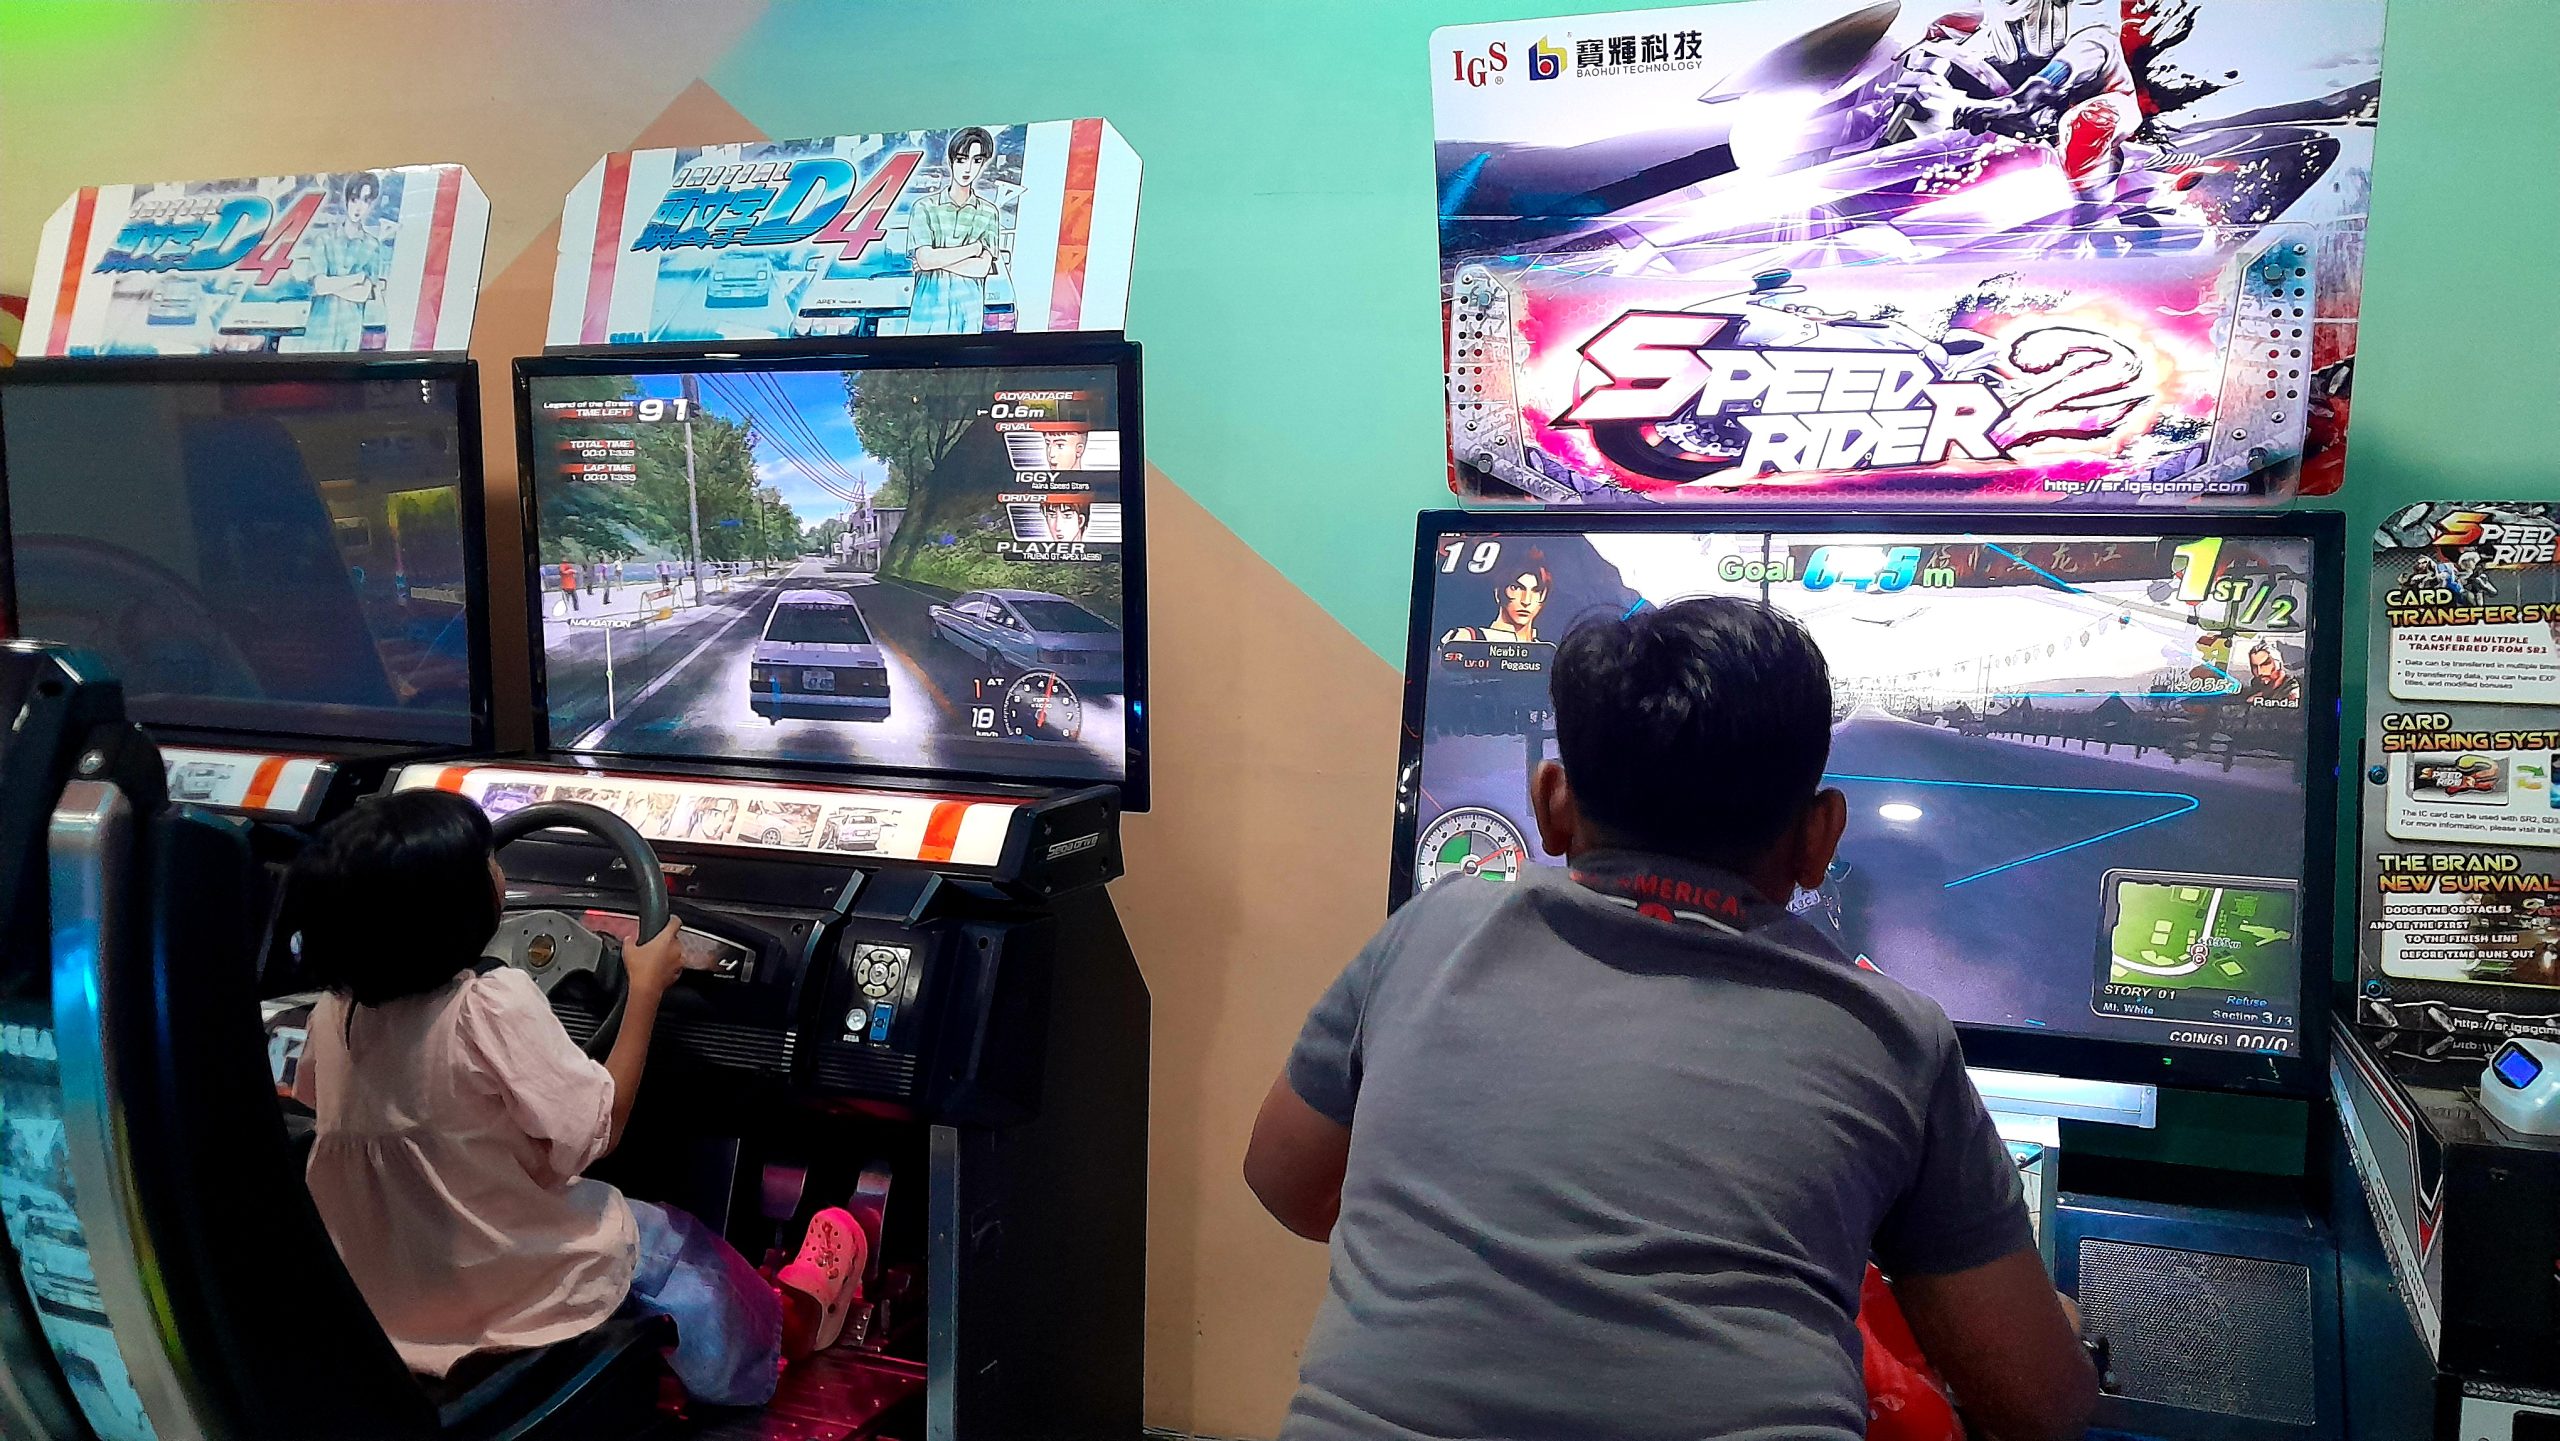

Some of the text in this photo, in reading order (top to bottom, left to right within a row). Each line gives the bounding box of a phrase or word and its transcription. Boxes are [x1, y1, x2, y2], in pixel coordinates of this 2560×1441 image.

[1576, 30, 1702, 68] 寶輝科技
[1453, 42, 1508, 88] IGS
[1576, 61, 1702, 78] BAOHUI TECHNOLOGY
[811, 150, 924, 261] 4
[236, 192, 327, 286] 4
[1550, 309, 1943, 428] SPEED
[998, 391, 1073, 401] ADVANTAGE
[1738, 324, 2158, 475] RIDER 2
[588, 400, 604, 408] the
[638, 399, 688, 421] 91
[576, 408, 630, 417] TIME LEFT
[999, 423, 1034, 431] RIVAL
[570, 440, 631, 449] TOTAL TIME
[583, 464, 632, 472] LAP TIME
[1015, 471, 1060, 483] IGGY
[1001, 494, 1048, 502] DRIVER
[2433, 511, 2557, 546] SPEED
[997, 541, 1085, 553] PLAYER
[1440, 540, 1502, 574] 19
[1717, 554, 1796, 583] Goal
[1922, 563, 1956, 589] m
[2386, 589, 2453, 607] CARD
[2387, 606, 2521, 627] TRANSFER
[570, 619, 631, 628] NAVIGATION
[2398, 633, 2529, 644] DATA CAN BE MULTIPLE
[1489, 644, 1529, 658] Newbie
[2408, 642, 2489, 653] TRANSFERRED
[2491, 645, 2524, 653] FROM
[1500, 659, 1541, 672] Pegasus
[2405, 658, 2423, 666] Data
[2452, 660, 2496, 668] transferred
[2506, 662, 2538, 670] multiple
[986, 678, 1004, 686] AT
[2404, 670, 2416, 679] By
[2417, 671, 2462, 680] transferring
[2485, 674, 2500, 682] you
[2517, 673, 2537, 681] have
[2428, 679, 2443, 687] and
[2444, 680, 2478, 688] modified
[2479, 681, 2513, 689] bonuses
[2253, 696, 2300, 709] Randal
[2383, 713, 2450, 731] CARD
[975, 730, 999, 738] km/h
[2383, 732, 2490, 751] SHARING
[2402, 809, 2416, 817] The
[2418, 810, 2428, 818] IC
[2429, 811, 2448, 819] card
[2478, 813, 2500, 821] used
[2501, 814, 2518, 822] with
[2438, 821, 2488, 831] information,
[2489, 824, 2517, 833] please
[2378, 854, 2518, 872] THE BRAND
[2379, 875, 2433, 892] NEW
[2385, 905, 2423, 915] DODGE
[2425, 905, 2448, 915] THE
[2450, 905, 2512, 915] OBSTACLES
[2369, 921, 2470, 930] AND BE THE FIRST
[2406, 934, 2519, 944] TO THE FINISH LINE
[2401, 950, 2536, 959] BEFORE TIME RUNS OUT
[2104, 984, 2177, 1000] STORY 01
[2212, 1009, 2258, 1022] Section
